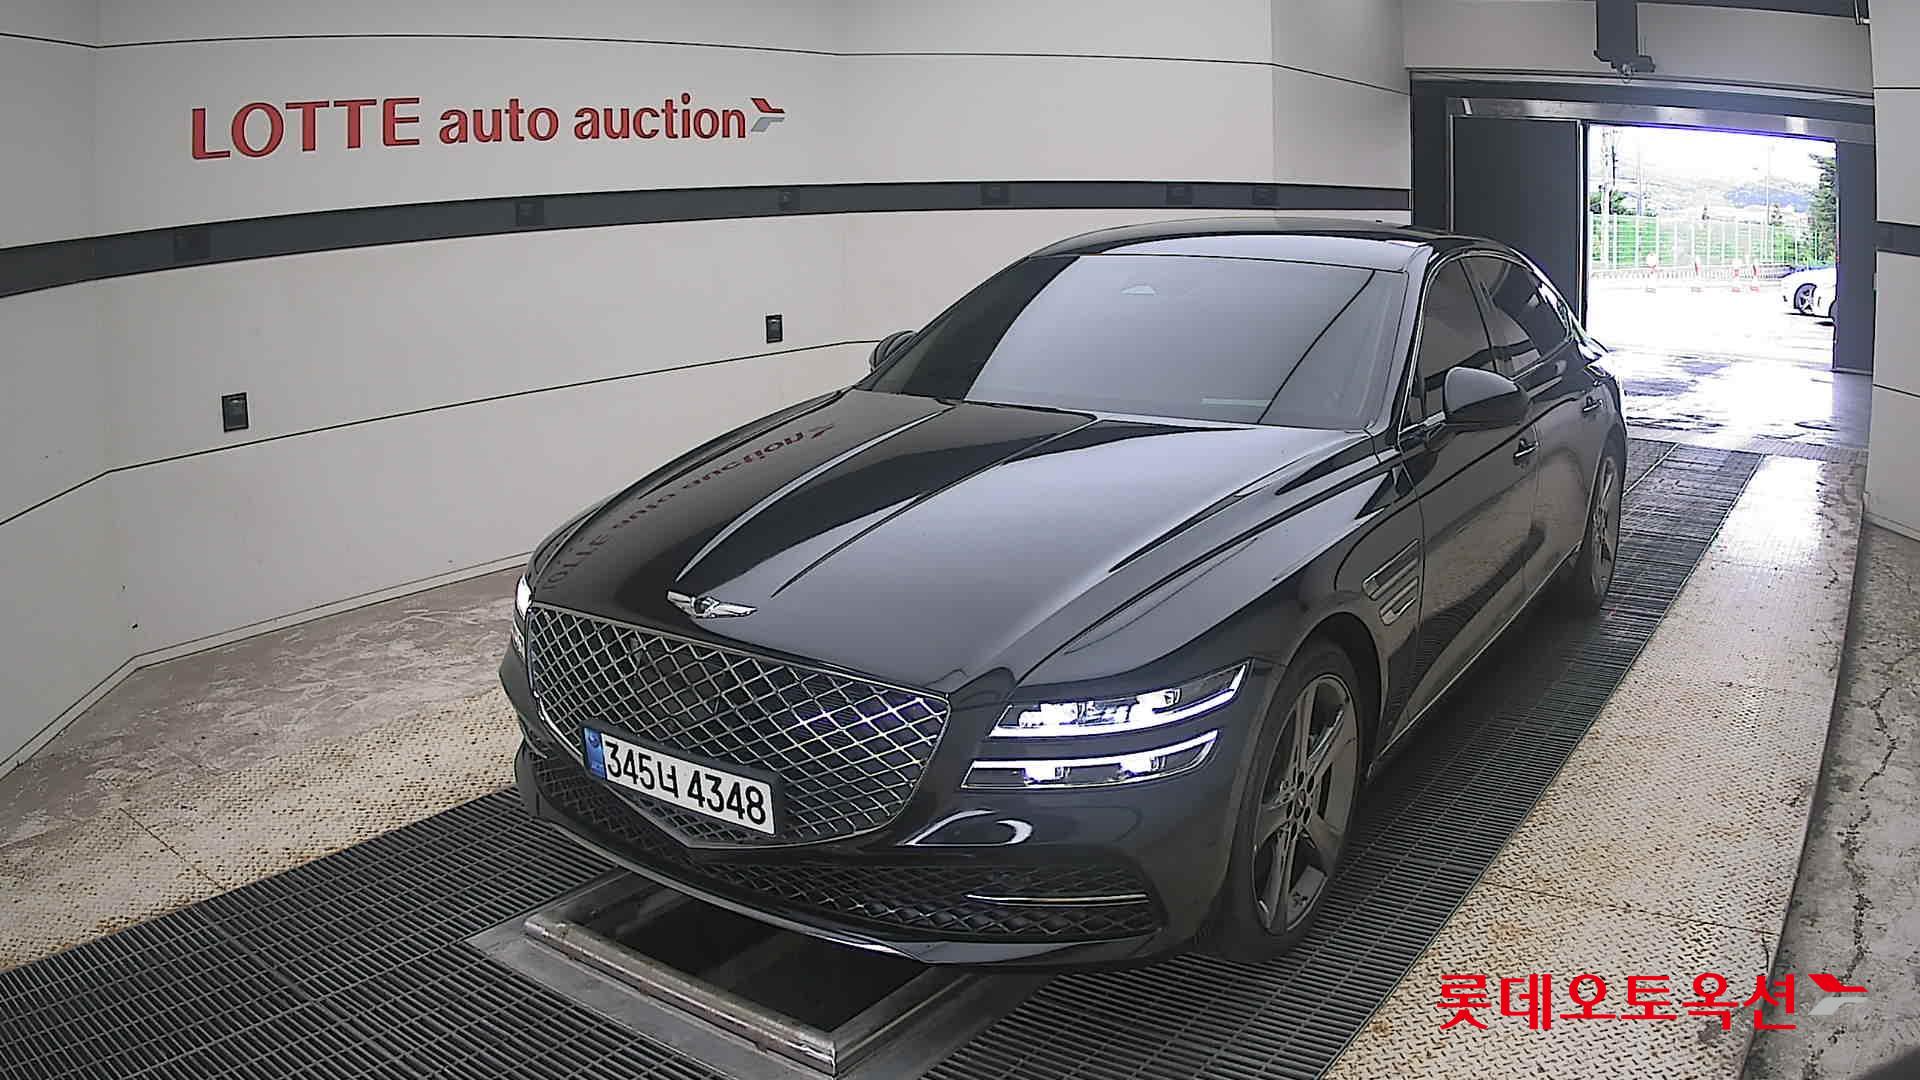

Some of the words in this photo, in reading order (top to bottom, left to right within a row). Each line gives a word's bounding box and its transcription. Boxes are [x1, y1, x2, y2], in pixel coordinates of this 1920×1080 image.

[192, 97, 420, 160] LOTTE
[438, 98, 560, 145] auto
[574, 93, 747, 140] auction
[604, 741, 680, 799] 345너
[686, 769, 767, 826] 4348
